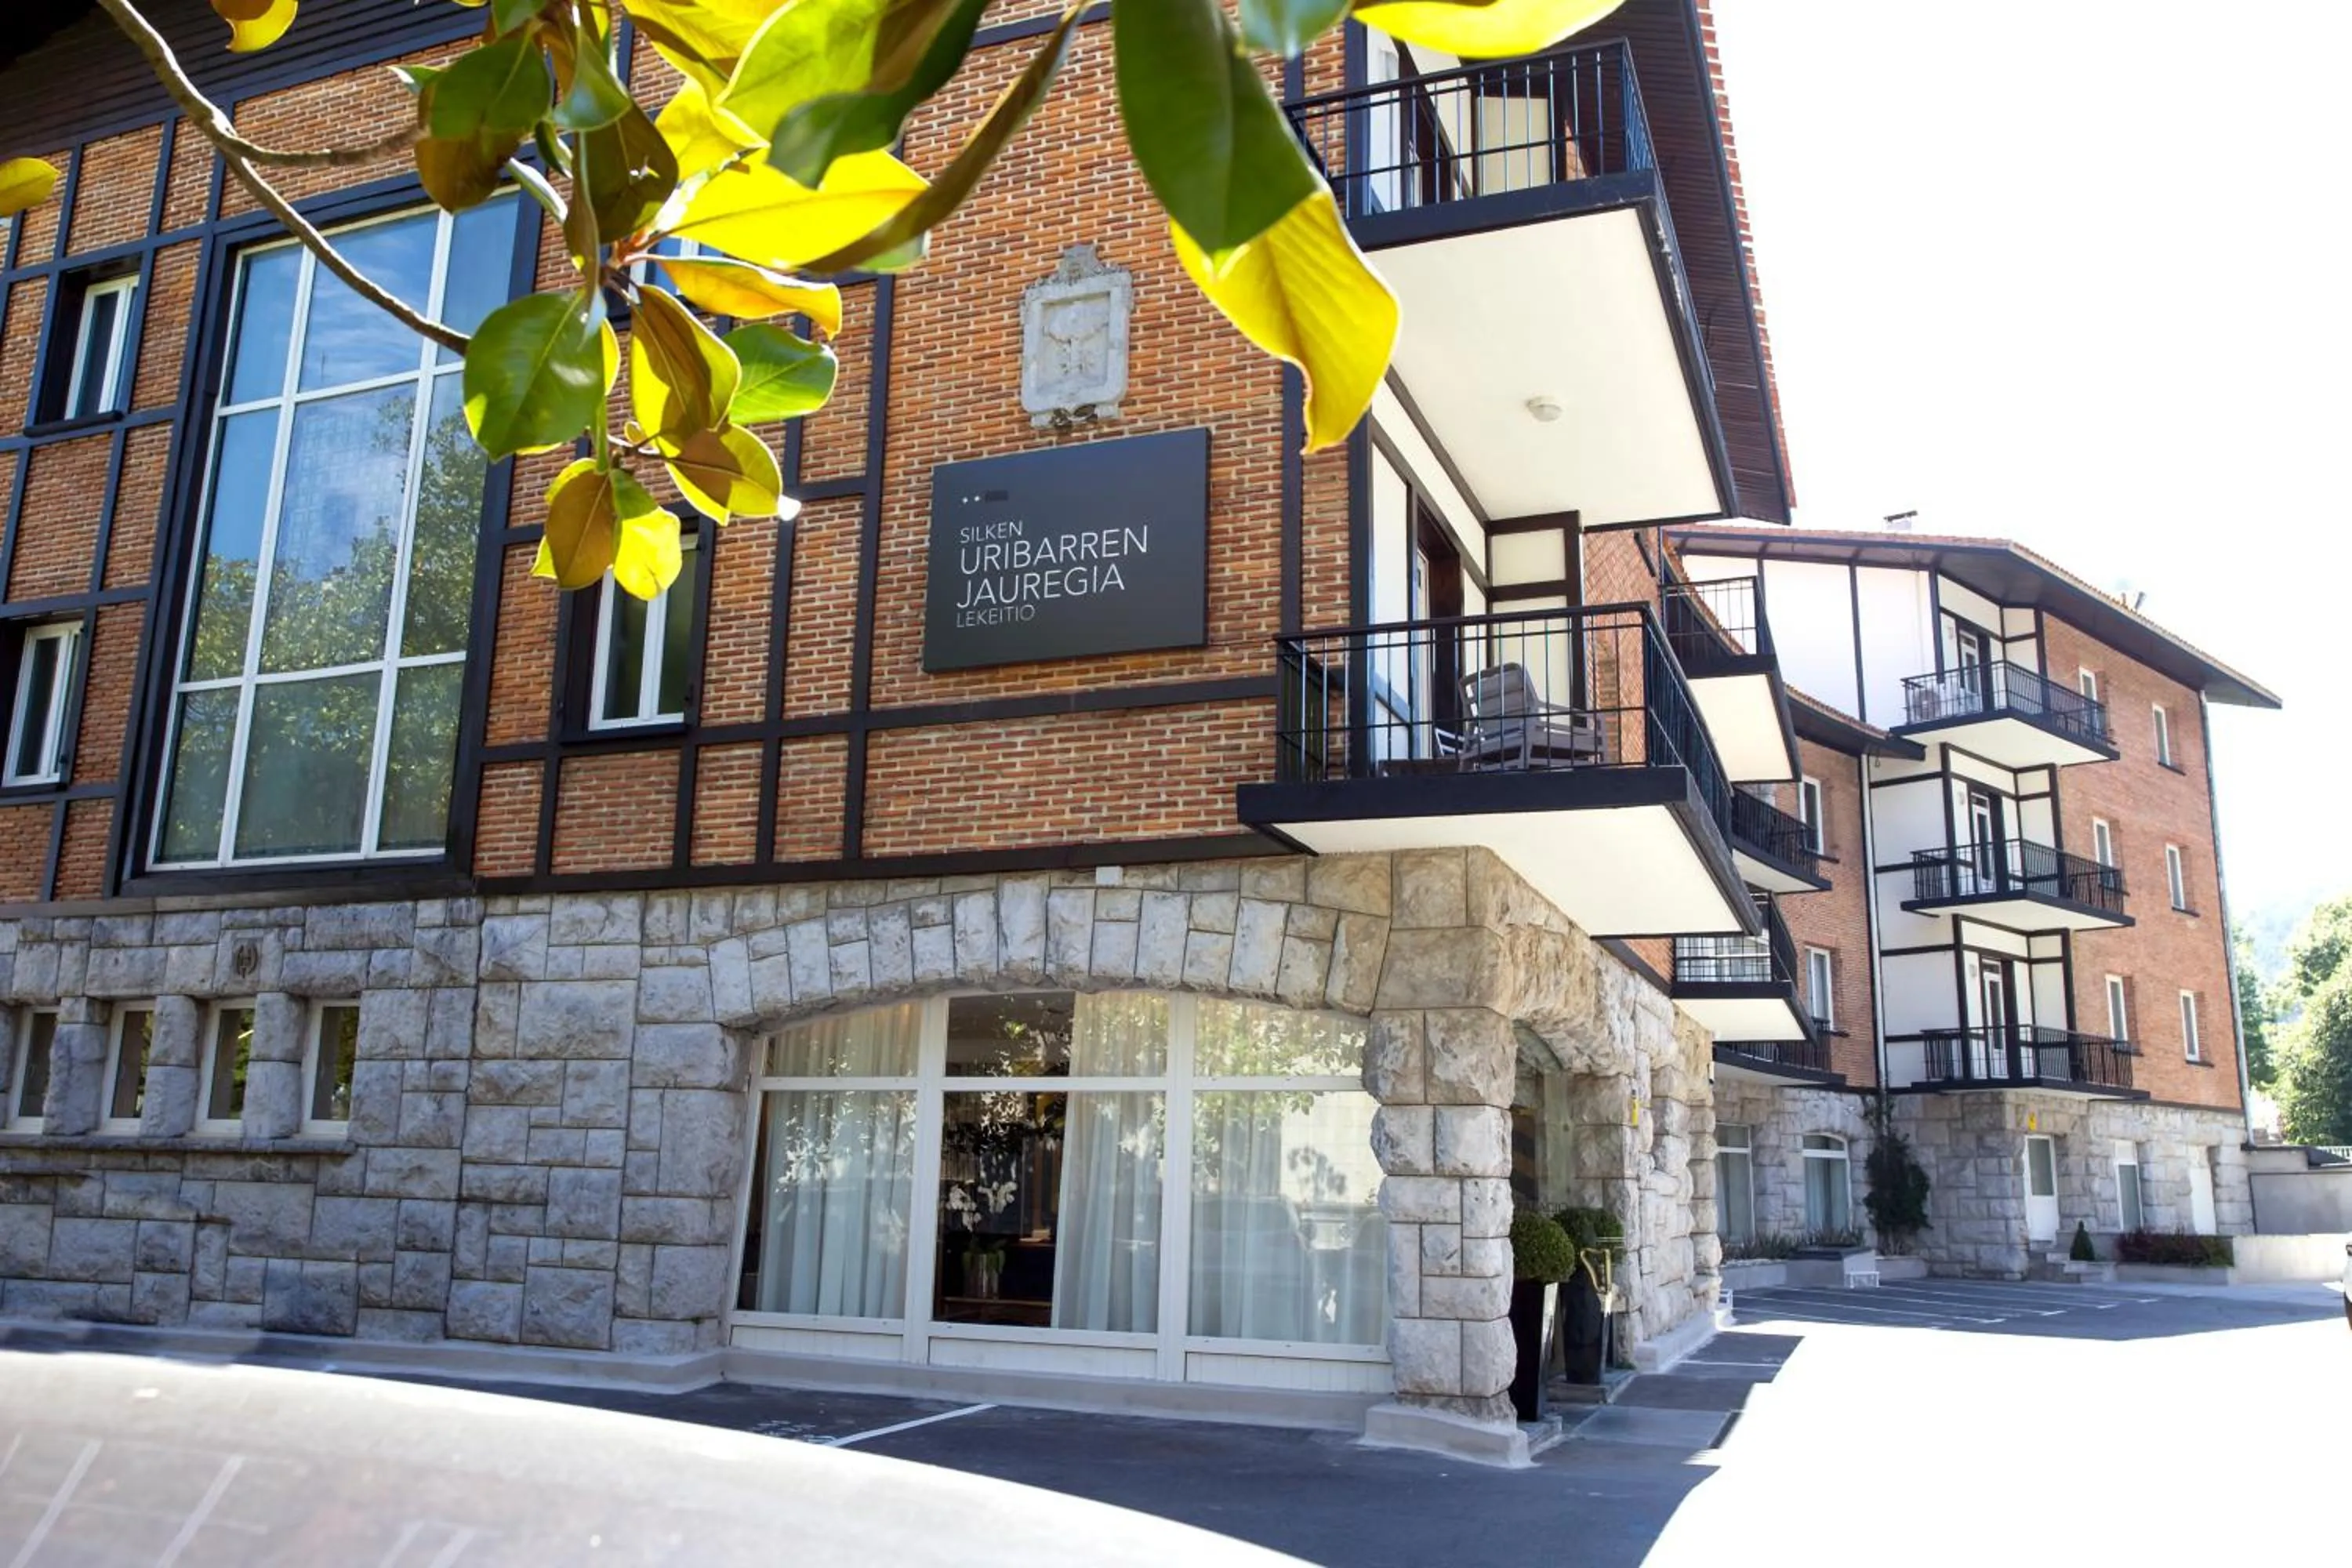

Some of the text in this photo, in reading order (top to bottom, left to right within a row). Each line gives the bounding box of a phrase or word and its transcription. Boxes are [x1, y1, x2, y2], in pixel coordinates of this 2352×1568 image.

[960, 521, 1022, 544] SILKEN
[960, 524, 1148, 575] URIBARREN
[956, 564, 1125, 608] JAUREGIA
[956, 604, 1036, 627] LEKEITIO
